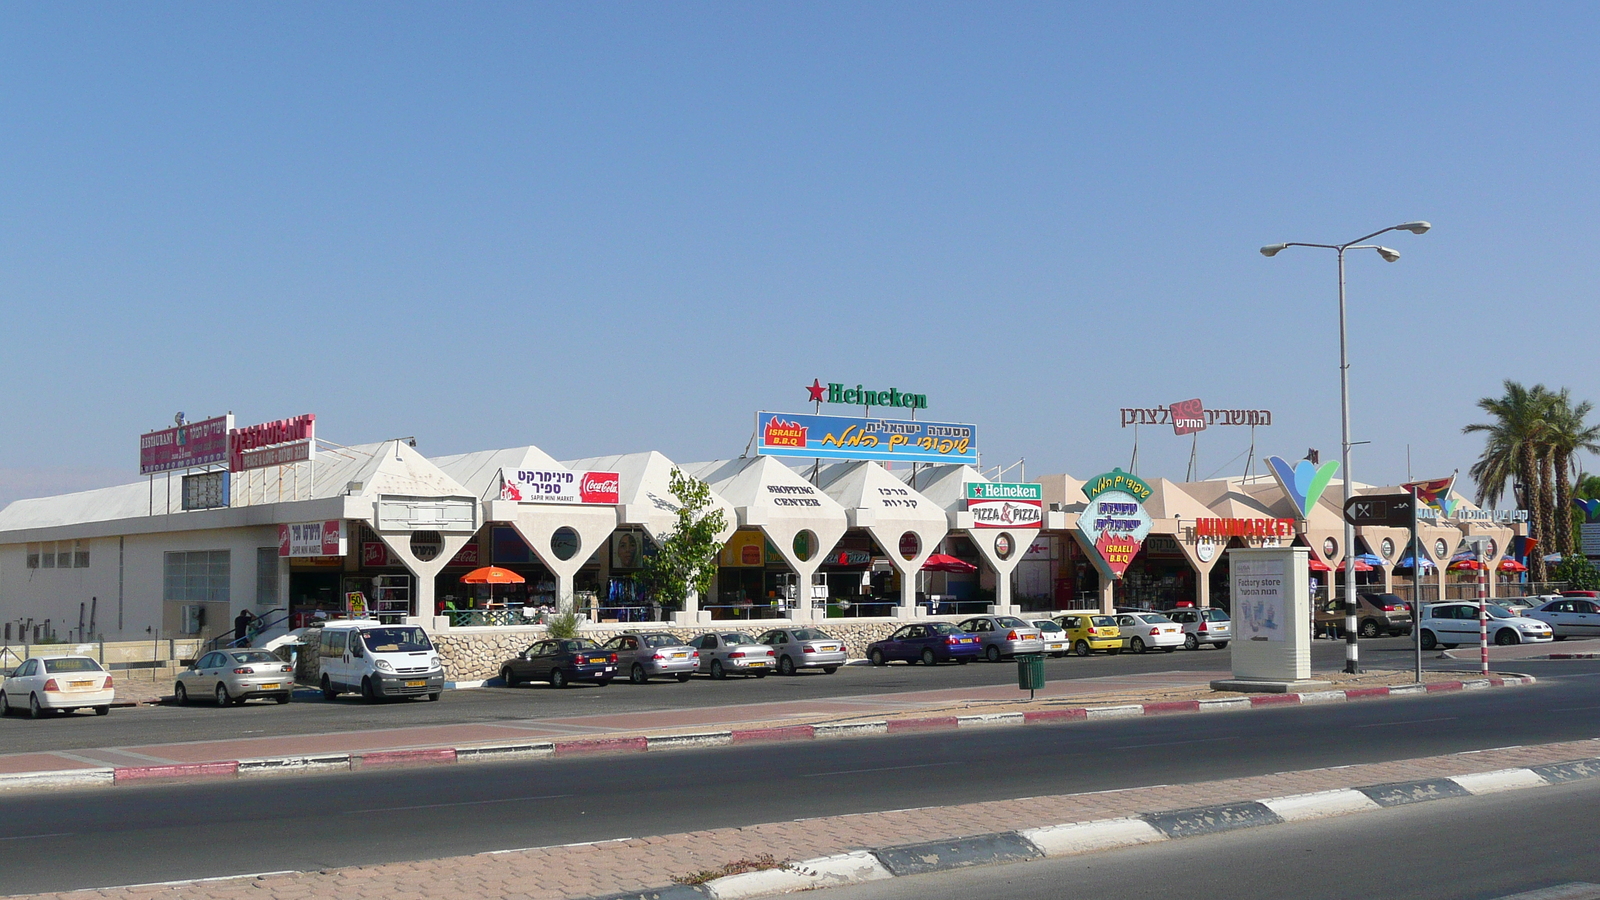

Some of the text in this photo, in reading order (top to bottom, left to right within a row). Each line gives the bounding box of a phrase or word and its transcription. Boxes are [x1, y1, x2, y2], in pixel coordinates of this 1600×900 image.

[828, 382, 928, 409] Heineken
[1120, 404, 1168, 428] לצרכן
[1203, 409, 1272, 426] המשביר
[866, 420, 970, 438] מסעדה ישראלית
[1176, 419, 1204, 428] החדש
[769, 428, 801, 437] ISRAELI
[821, 424, 969, 454] שיפודי ים המלח
[142, 432, 173, 449] RESTAURANT
[229, 413, 316, 473] RESTAURANT
[773, 437, 797, 446] B.B.Q
[517, 470, 574, 484] מינימרקט
[531, 482, 561, 494] ספיר
[767, 485, 815, 495] SHOPPING
[878, 487, 908, 496] מרכז
[985, 484, 1037, 497] Heineken
[774, 498, 821, 507] CENTER
[882, 498, 917, 508] קניות
[972, 502, 1040, 524] PIZZA & PIZZA
[1195, 518, 1294, 537] MINIMARKET
[1105, 545, 1133, 553] ISRAELI
[1238, 579, 1259, 587] Factory
